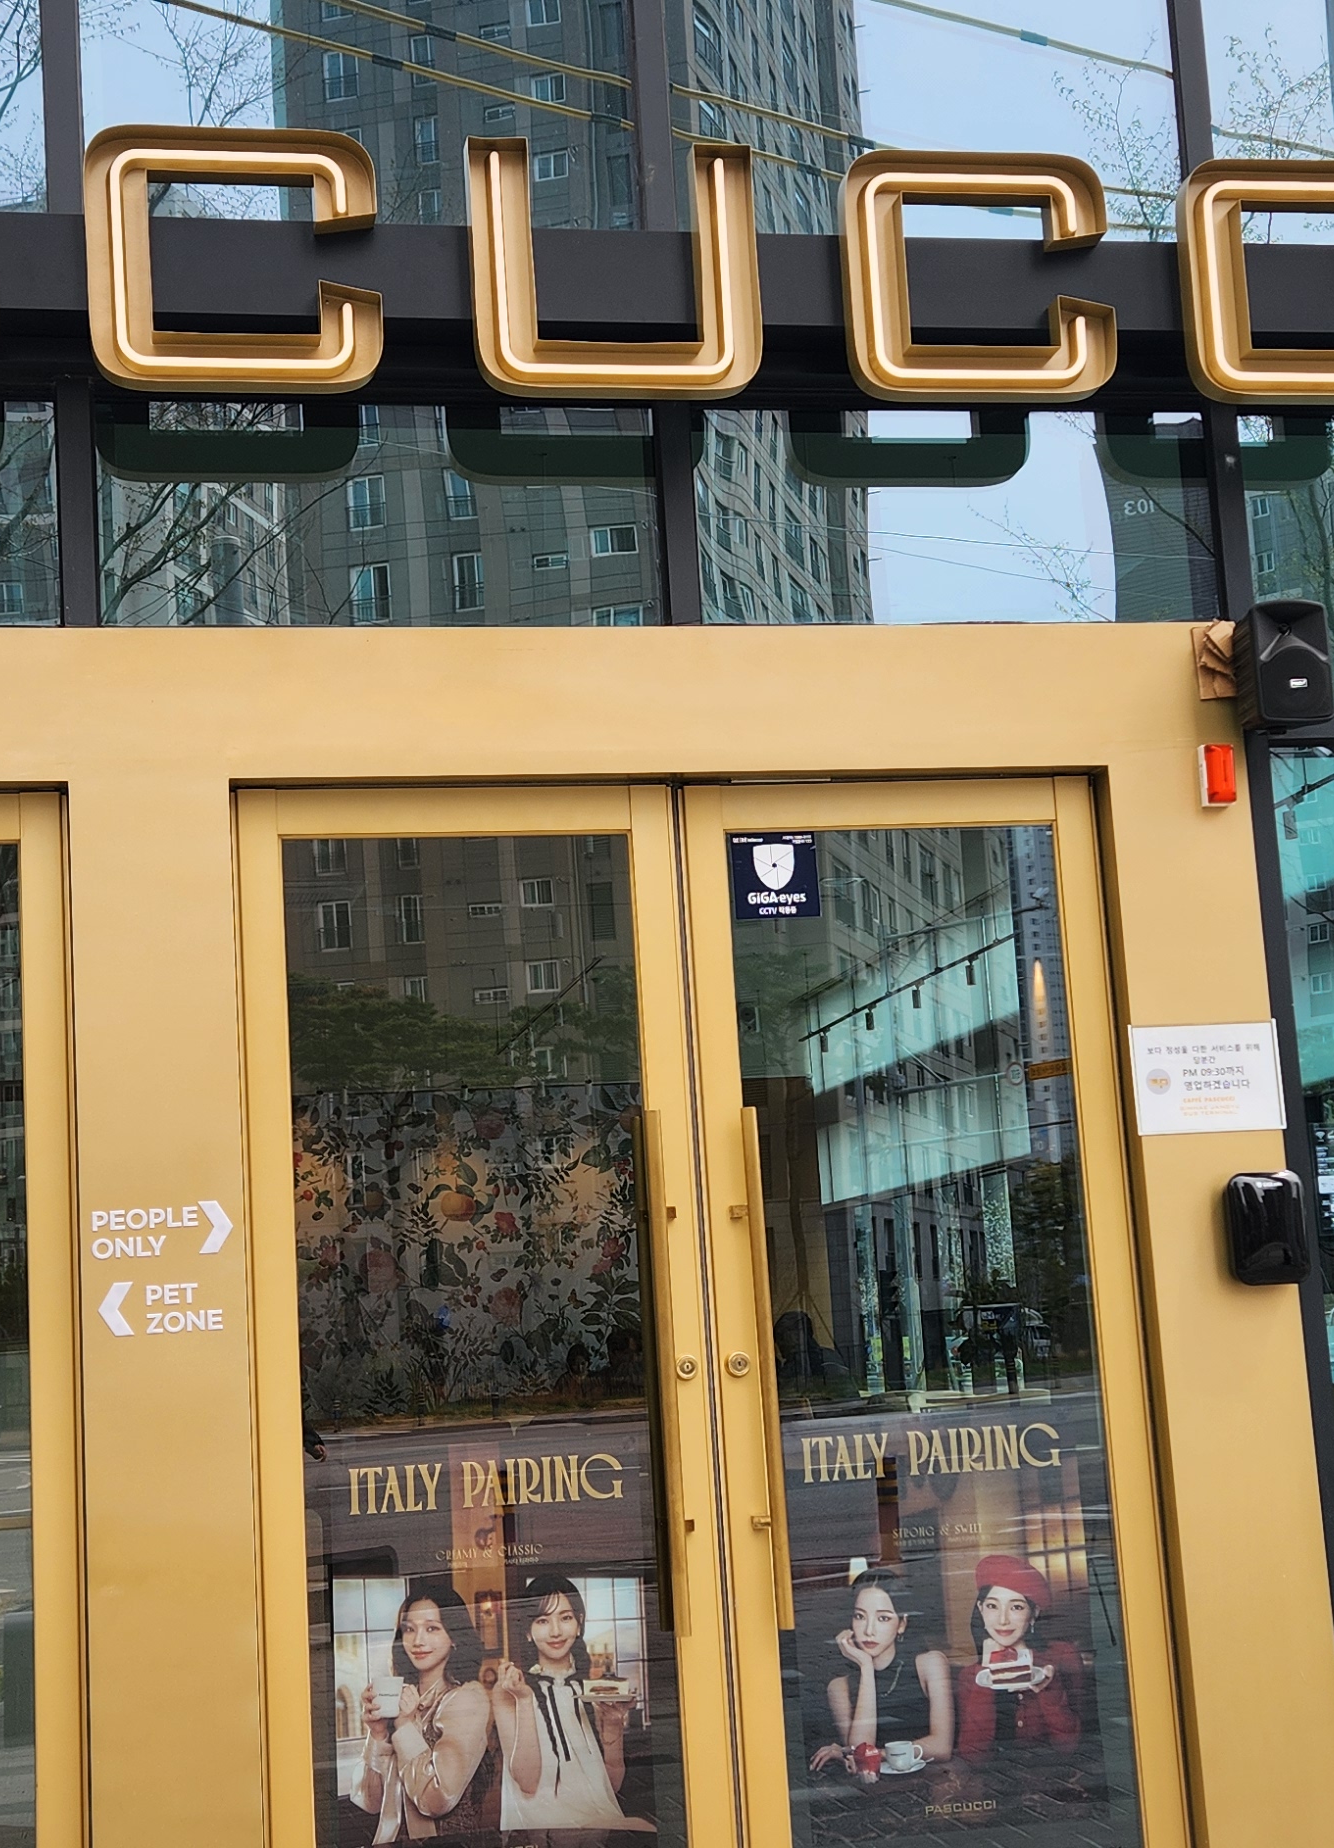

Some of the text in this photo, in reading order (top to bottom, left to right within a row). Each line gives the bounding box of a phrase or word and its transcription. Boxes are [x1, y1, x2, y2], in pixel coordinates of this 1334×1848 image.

[759, 906, 777, 915] CCTV
[1182, 1068, 1198, 1077] PM
[91, 1206, 199, 1232] PEOPLE
[91, 1235, 167, 1260] ONLY
[145, 1283, 199, 1306] PET
[146, 1309, 224, 1335] ZONE
[800, 1423, 1062, 1484] ITALY PAIRING
[348, 1453, 624, 1516] ITALY PAIRING
[892, 1525, 935, 1540] STRONG
[497, 1543, 544, 1557] CLASSIC
[925, 1799, 997, 1817] PASCUCCI
